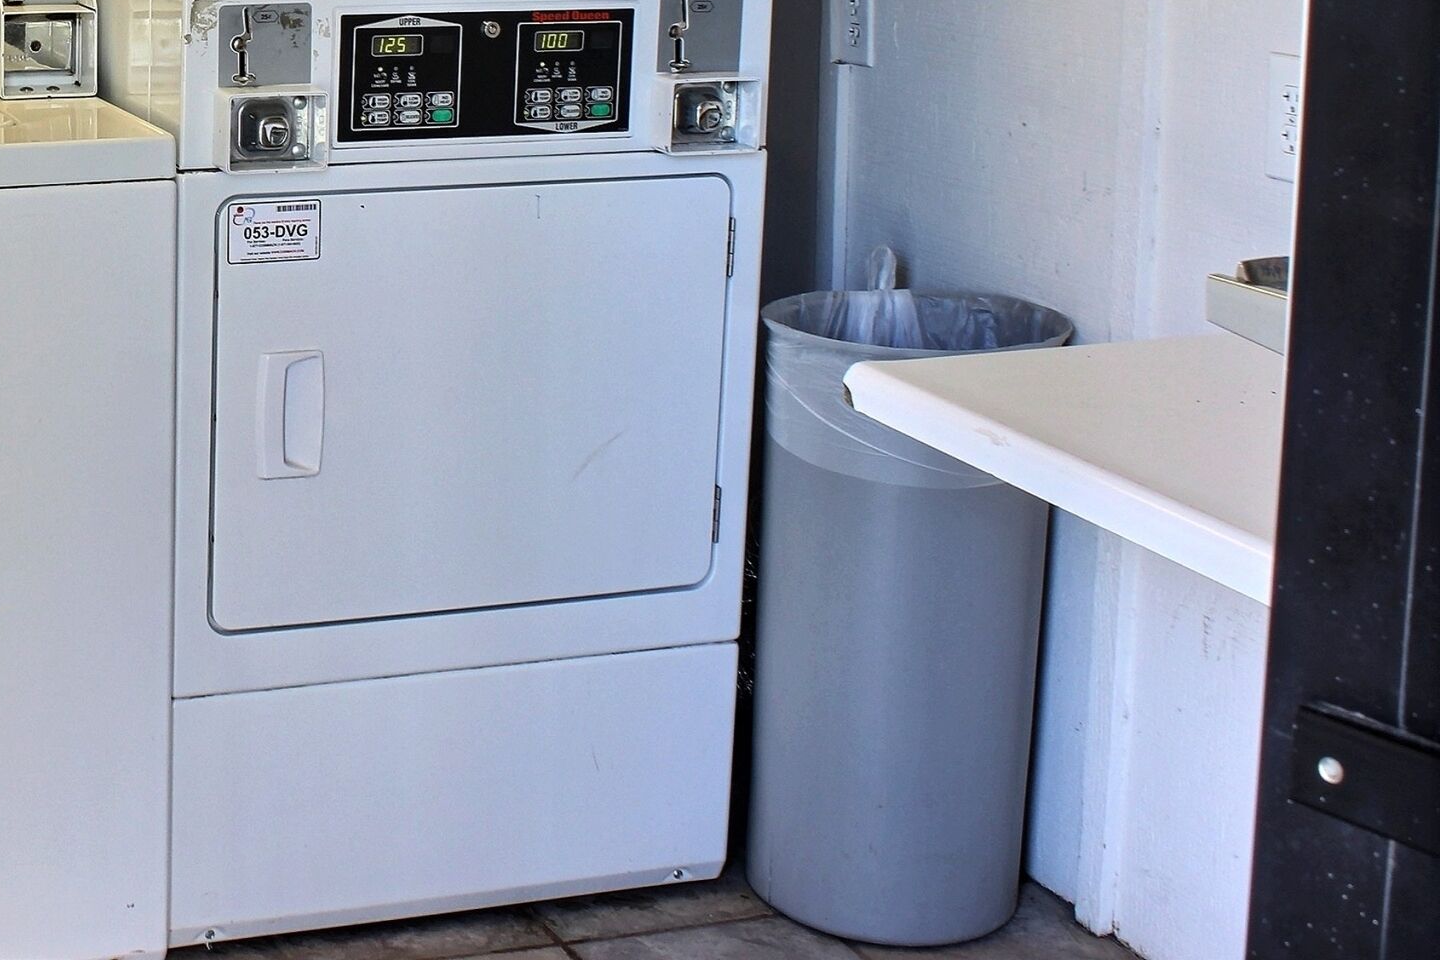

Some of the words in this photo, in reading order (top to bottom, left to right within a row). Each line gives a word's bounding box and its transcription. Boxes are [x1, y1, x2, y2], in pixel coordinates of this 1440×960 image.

[399, 17, 421, 27] UPPER
[532, 11, 569, 23] Speed
[572, 10, 610, 20] Queen
[379, 38, 406, 52] 125
[541, 34, 568, 48] 100
[555, 122, 578, 131] LOWER
[244, 224, 308, 240] 053-DVG
